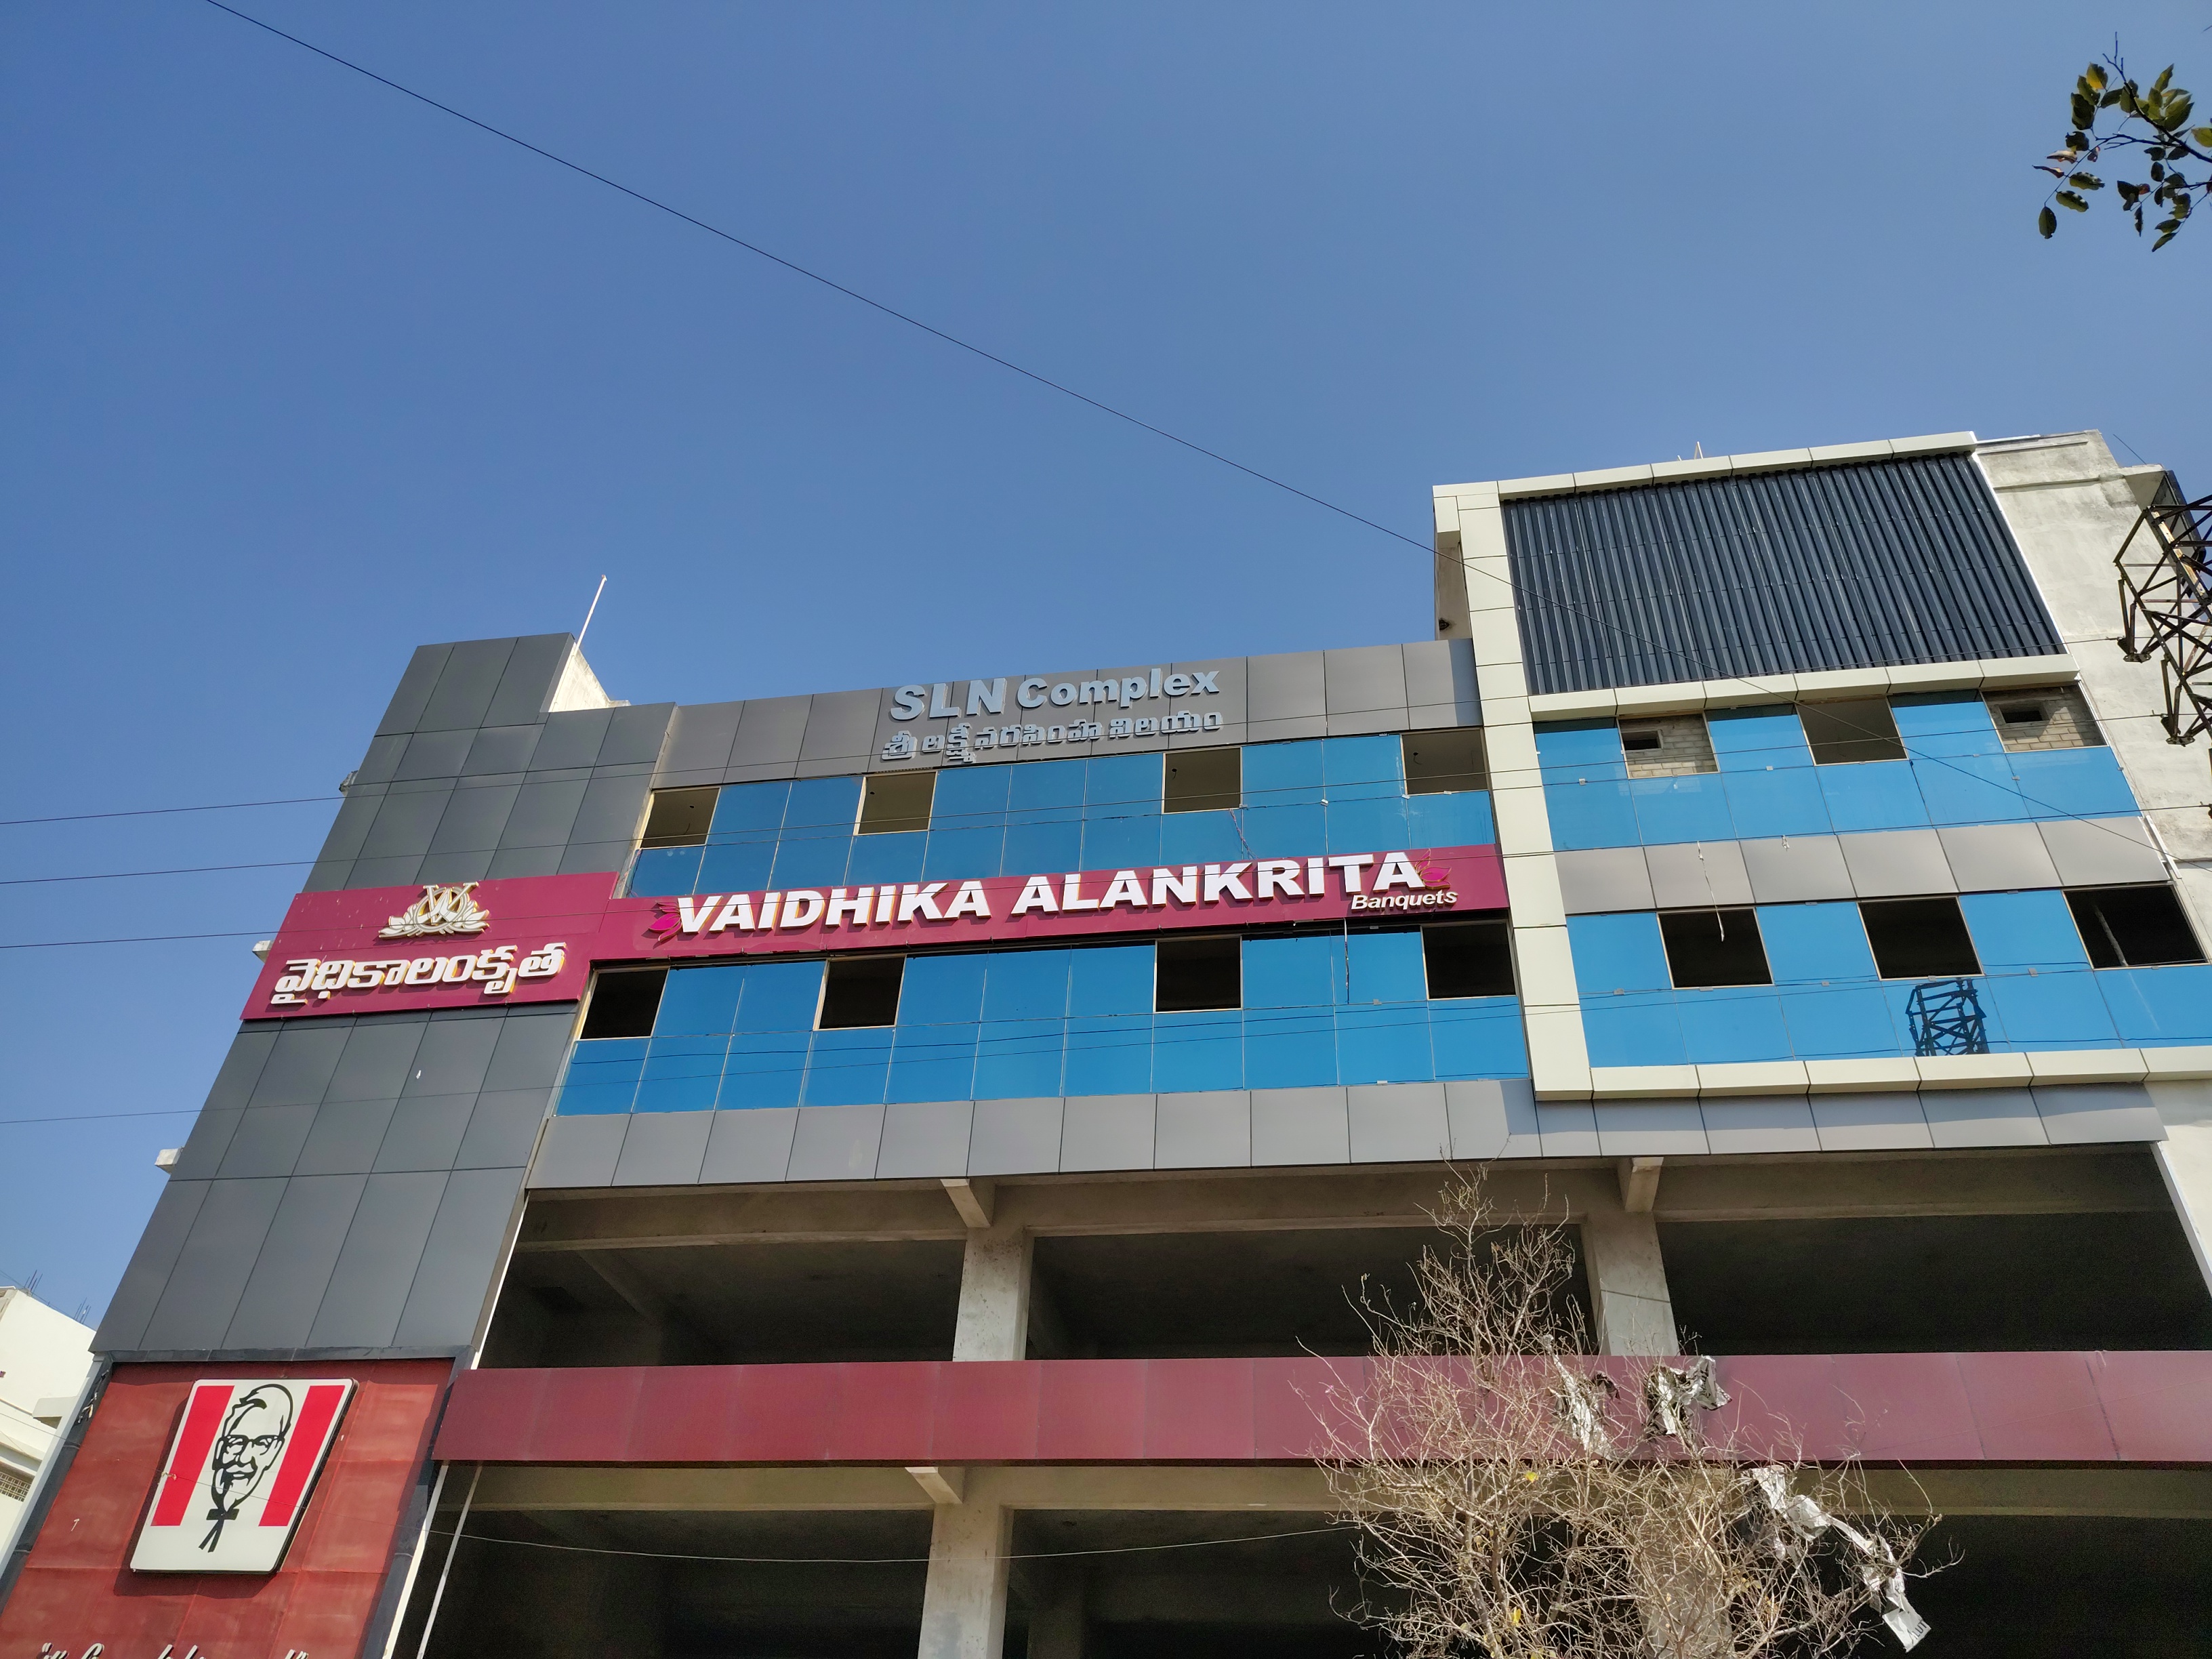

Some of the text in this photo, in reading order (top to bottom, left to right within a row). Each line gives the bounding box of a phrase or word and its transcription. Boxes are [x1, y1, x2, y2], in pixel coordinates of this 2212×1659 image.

[890, 668, 1220, 720] SLN Complex
[882, 730, 918, 760] శ్రీ
[1109, 710, 1223, 739] నిలయం
[677, 852, 1425, 934] VAIDHIKA ALANKRITA
[1351, 890, 1458, 912] Banquets
